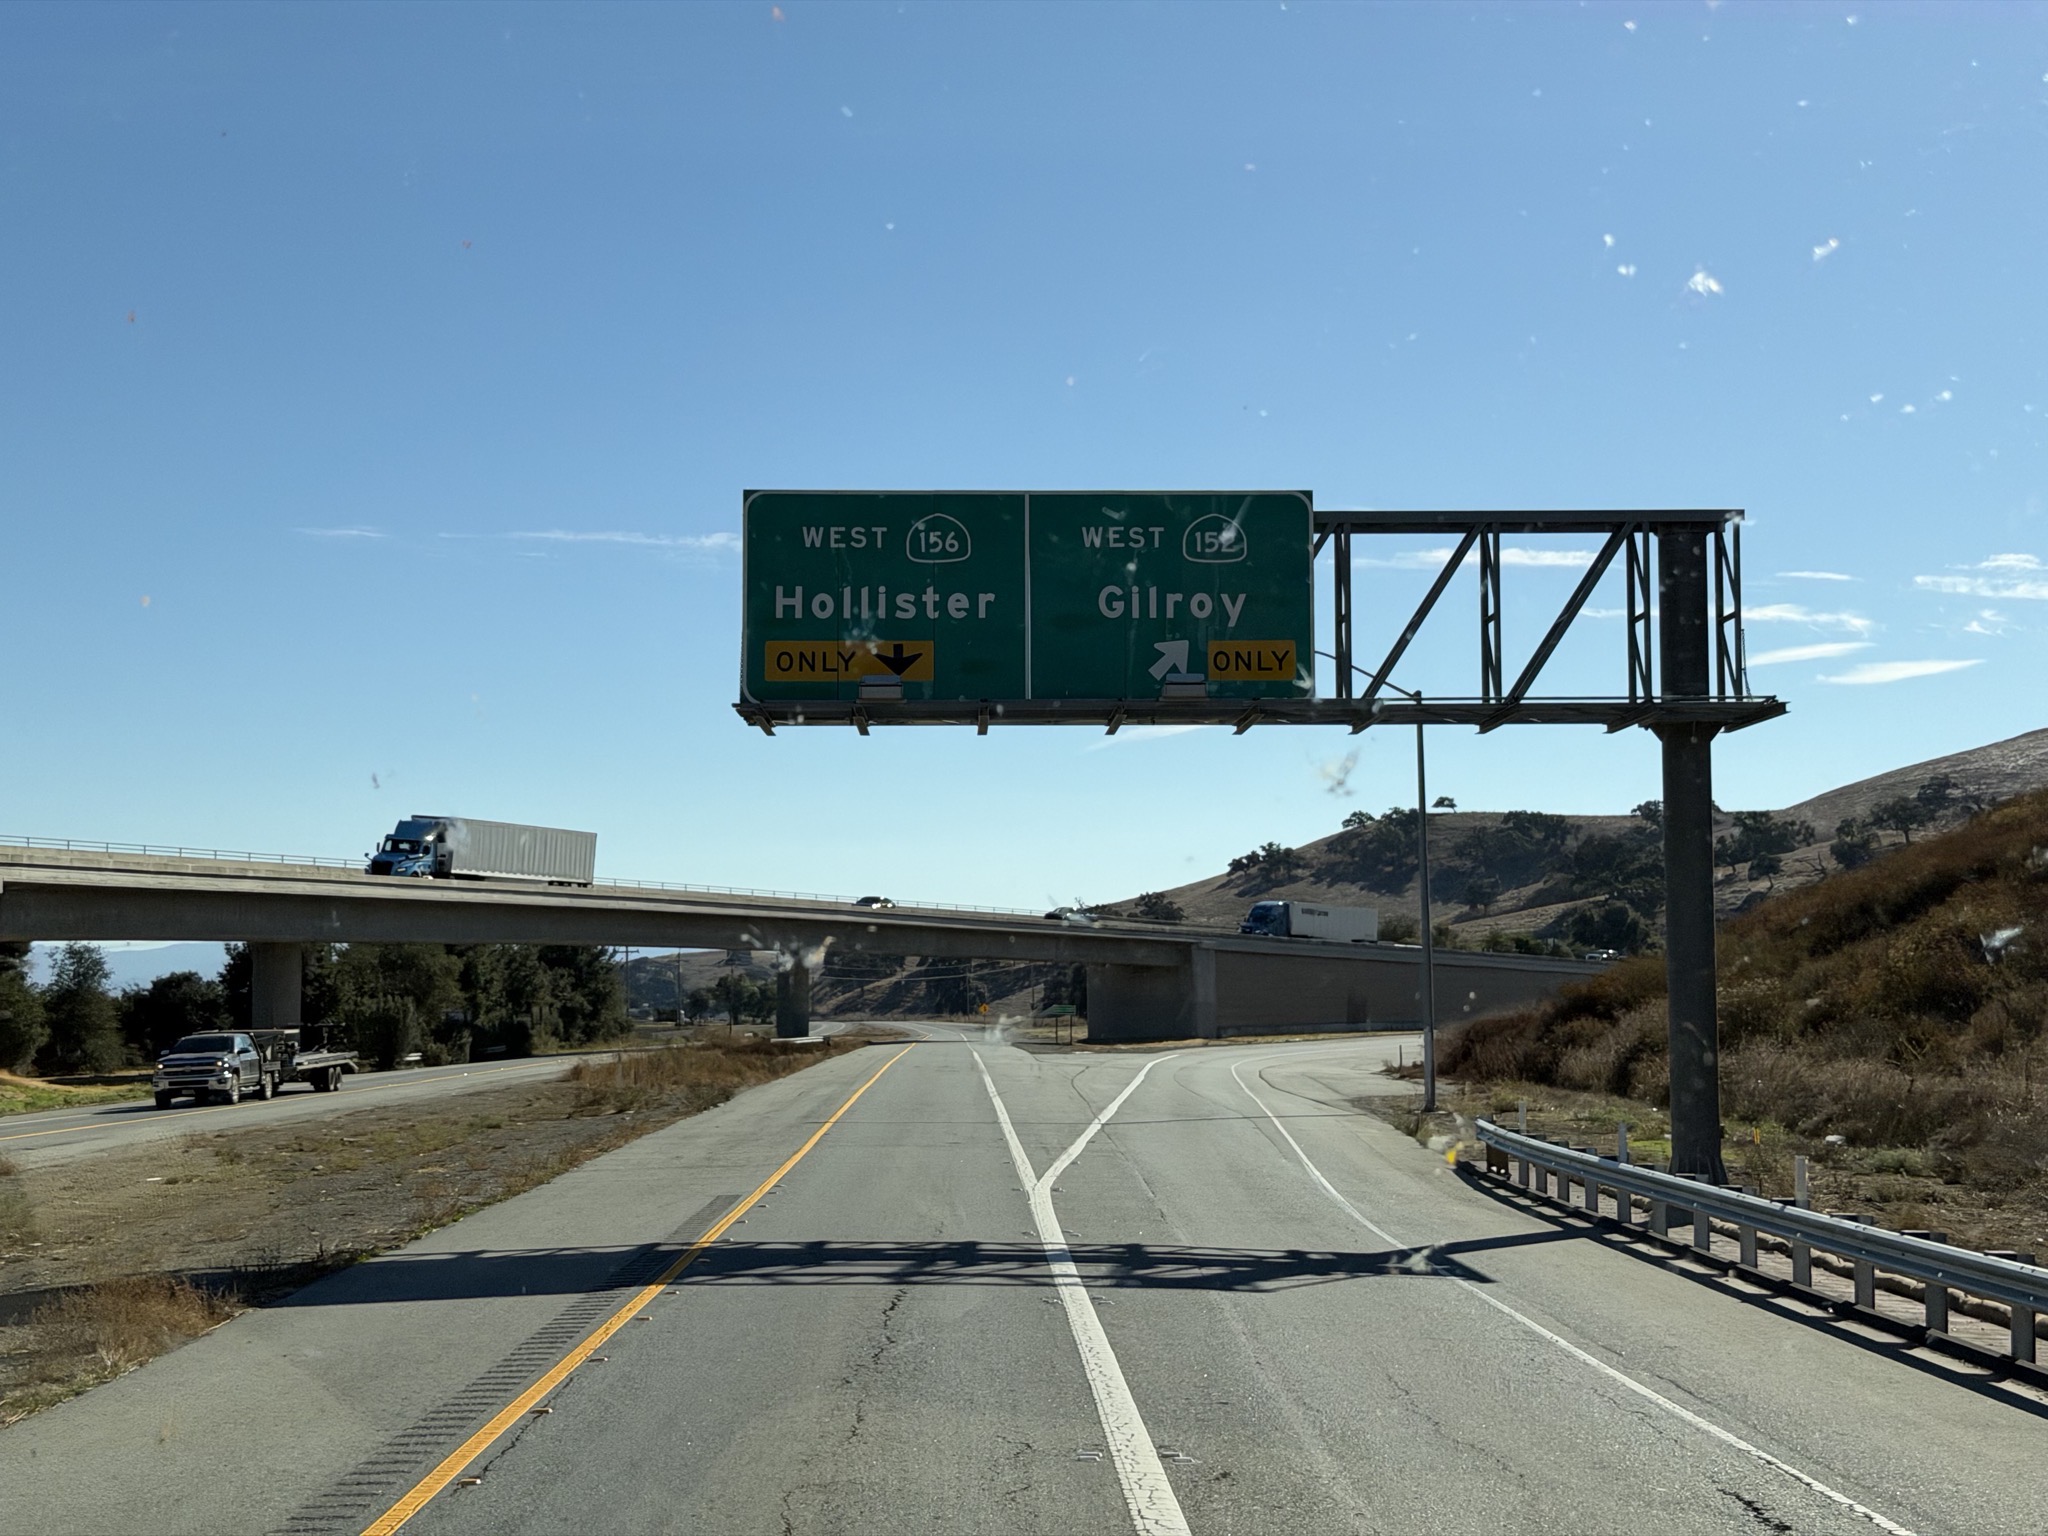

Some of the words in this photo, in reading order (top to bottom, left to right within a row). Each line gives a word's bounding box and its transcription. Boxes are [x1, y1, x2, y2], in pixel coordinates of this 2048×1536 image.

[802, 526, 888, 549] WEST
[919, 531, 960, 553] 156
[1081, 526, 1165, 549] WEST
[774, 585, 996, 620] Hollister
[1098, 584, 1247, 628] Gilroy
[775, 651, 857, 673] ONLY
[1213, 650, 1291, 672] ONLY
